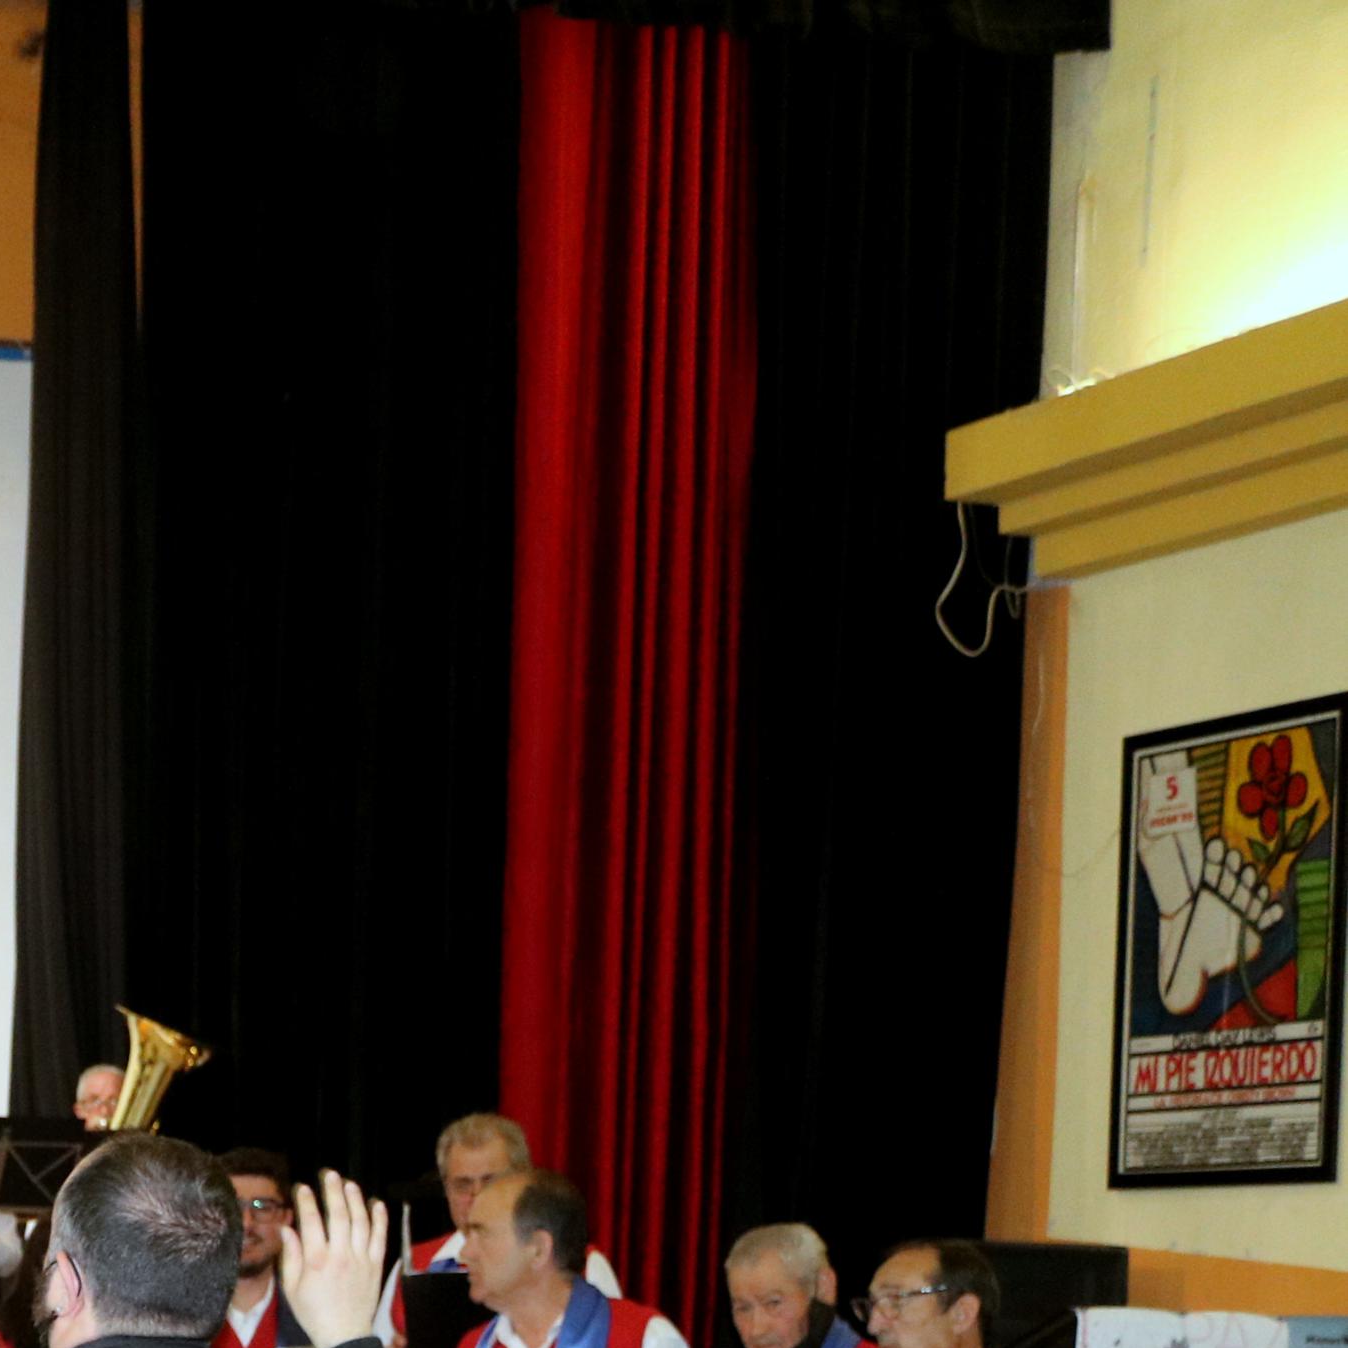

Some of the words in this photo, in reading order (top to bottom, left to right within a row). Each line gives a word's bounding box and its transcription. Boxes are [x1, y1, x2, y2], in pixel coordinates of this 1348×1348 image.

[1134, 1055, 1158, 1094] MI
[1164, 1051, 1199, 1090] PIE
[1204, 1039, 1317, 1088] IZQUIERDO
